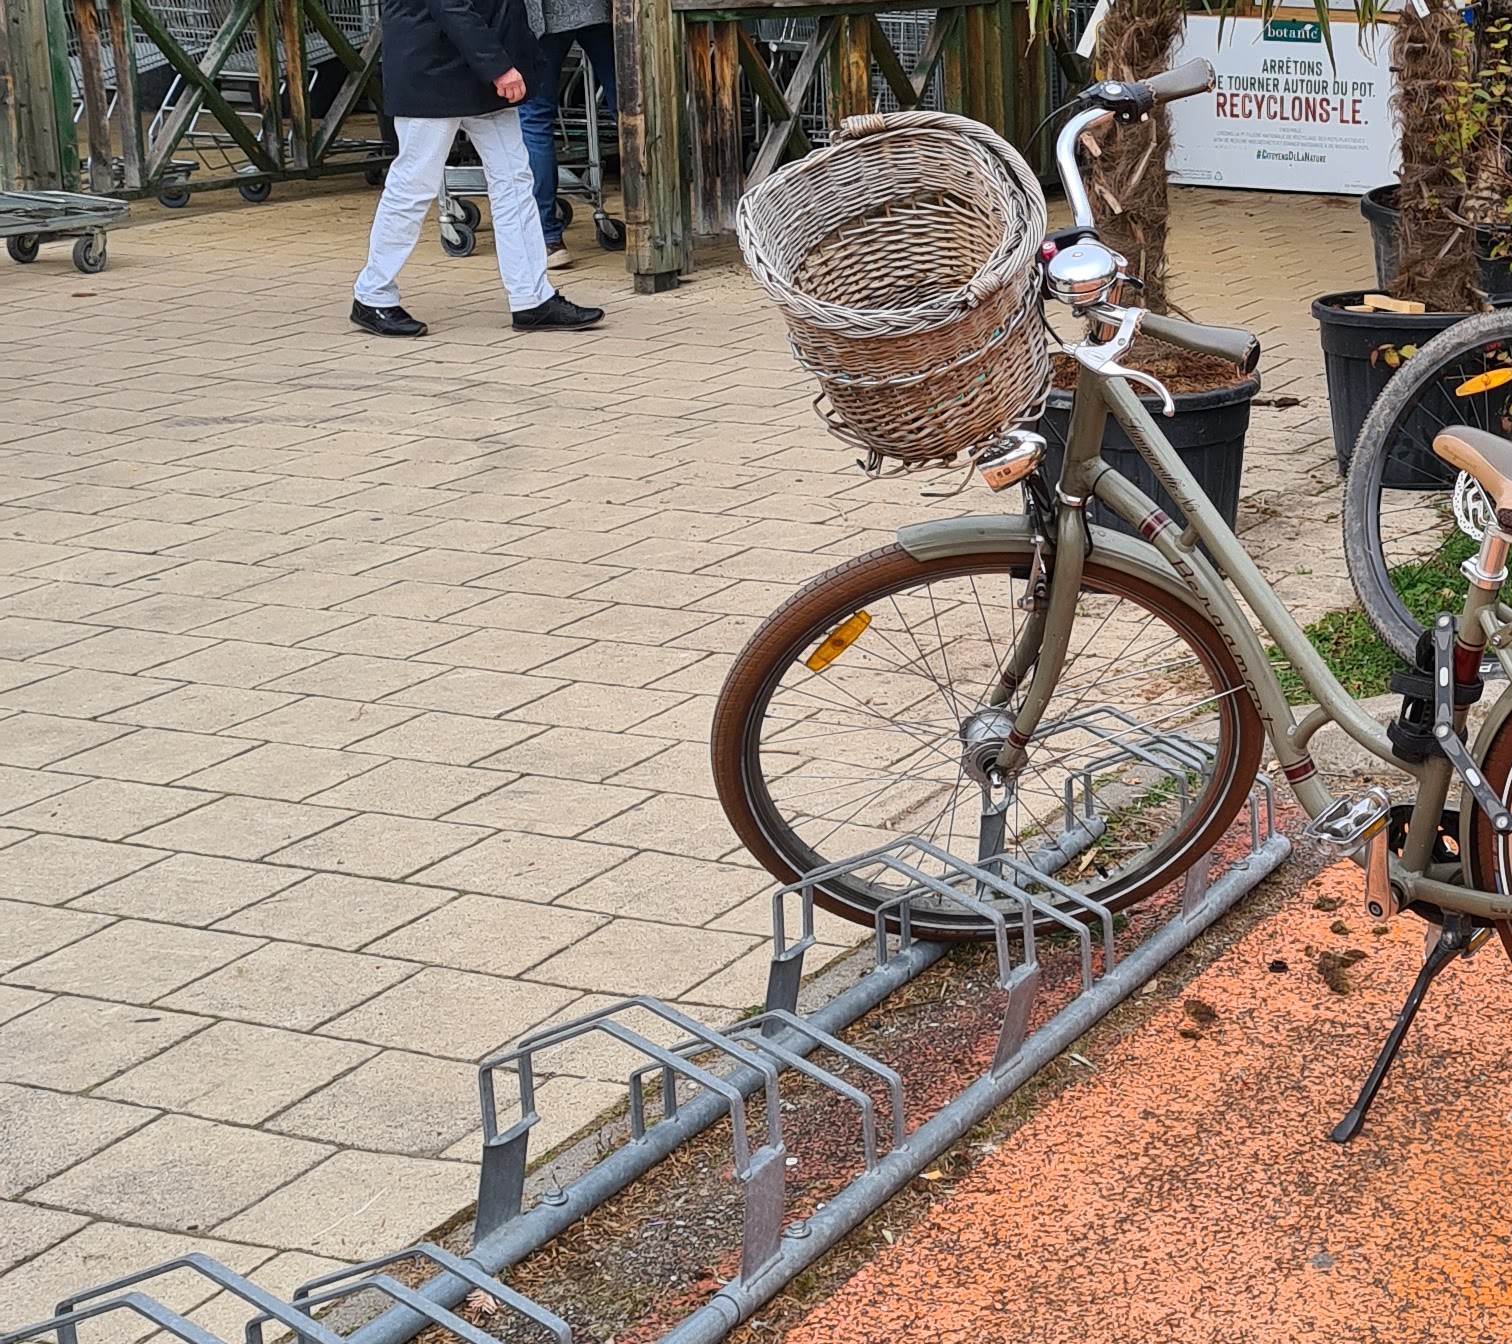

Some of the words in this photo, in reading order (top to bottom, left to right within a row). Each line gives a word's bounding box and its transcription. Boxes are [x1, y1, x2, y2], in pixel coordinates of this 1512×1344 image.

[1267, 24, 1318, 40] botanic
[1261, 56, 1323, 77] ARRÊTONS
[1227, 75, 1280, 94] TOURNER
[1283, 78, 1330, 97] AUTOUR
[1332, 80, 1349, 97] DU
[1351, 81, 1377, 99] POT.
[1216, 92, 1370, 126] RECYCLONS-LE.
